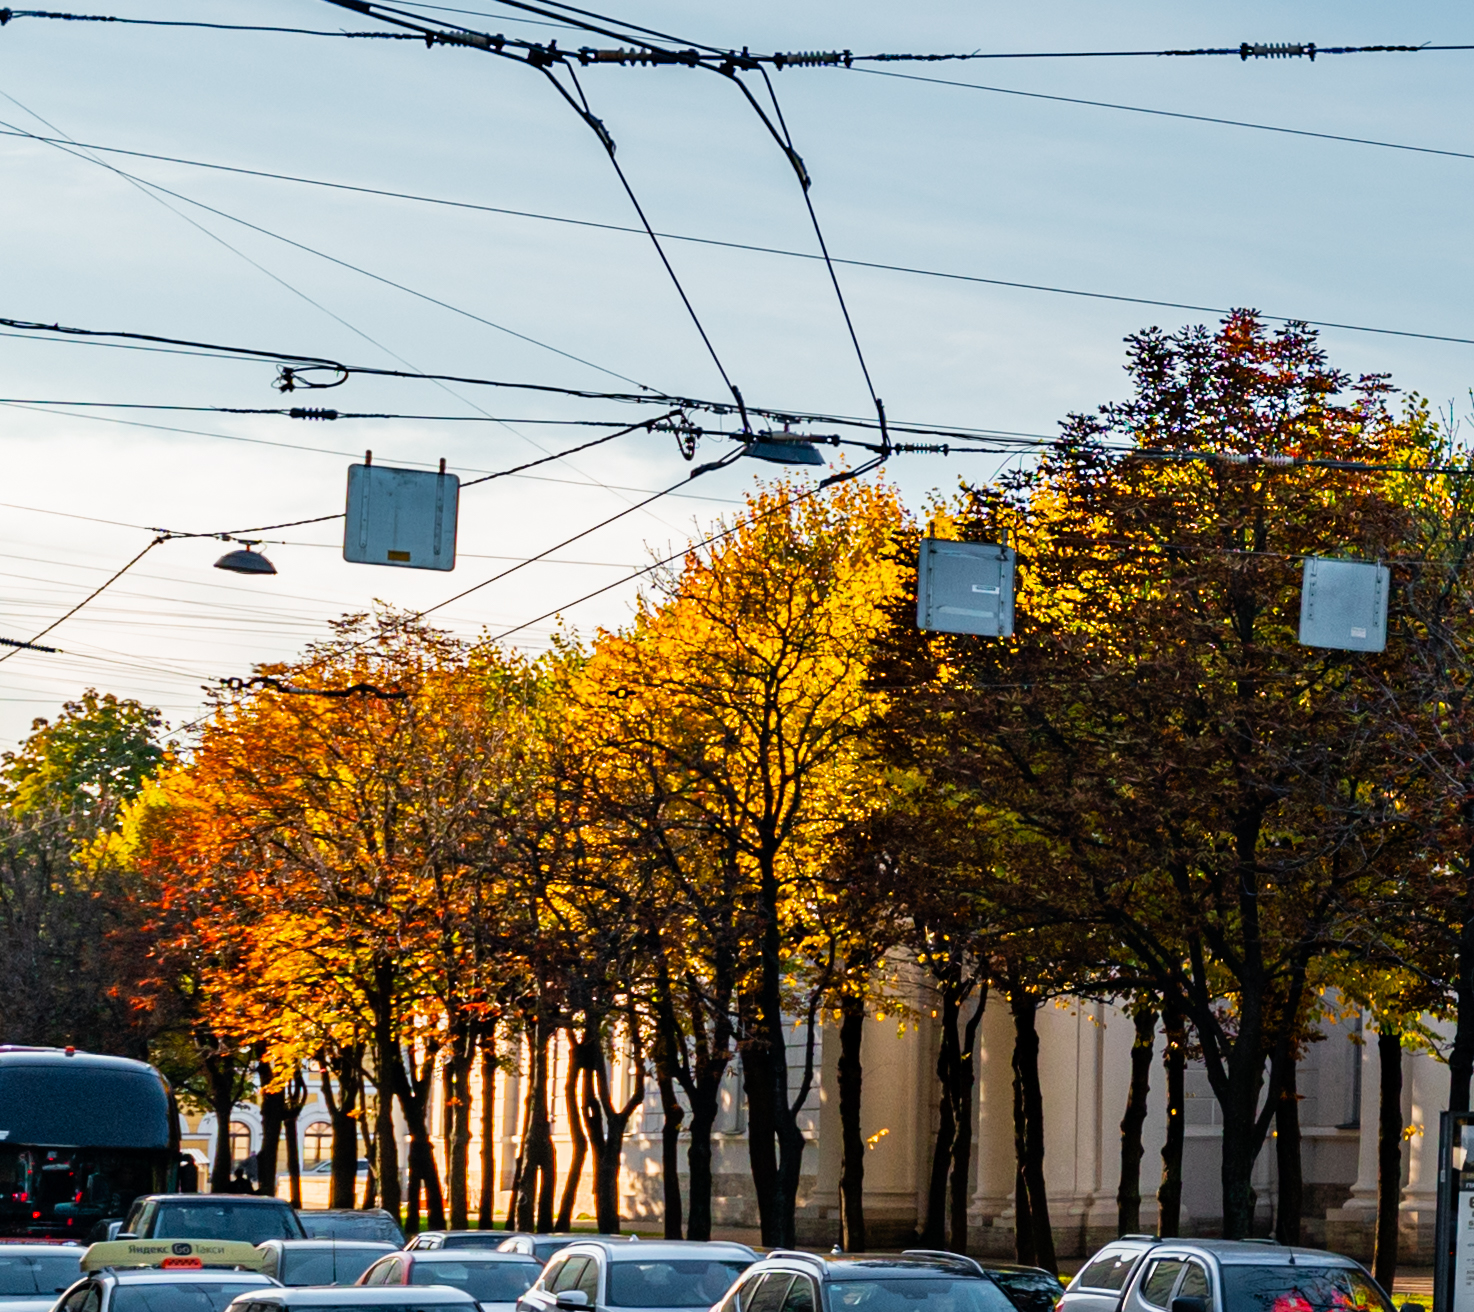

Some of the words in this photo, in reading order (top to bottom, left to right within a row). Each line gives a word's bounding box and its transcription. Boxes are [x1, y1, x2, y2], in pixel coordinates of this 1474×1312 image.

[128, 1245, 169, 1255] Яндекс
[174, 1244, 190, 1254] Go
[195, 1245, 225, 1254] Такси
